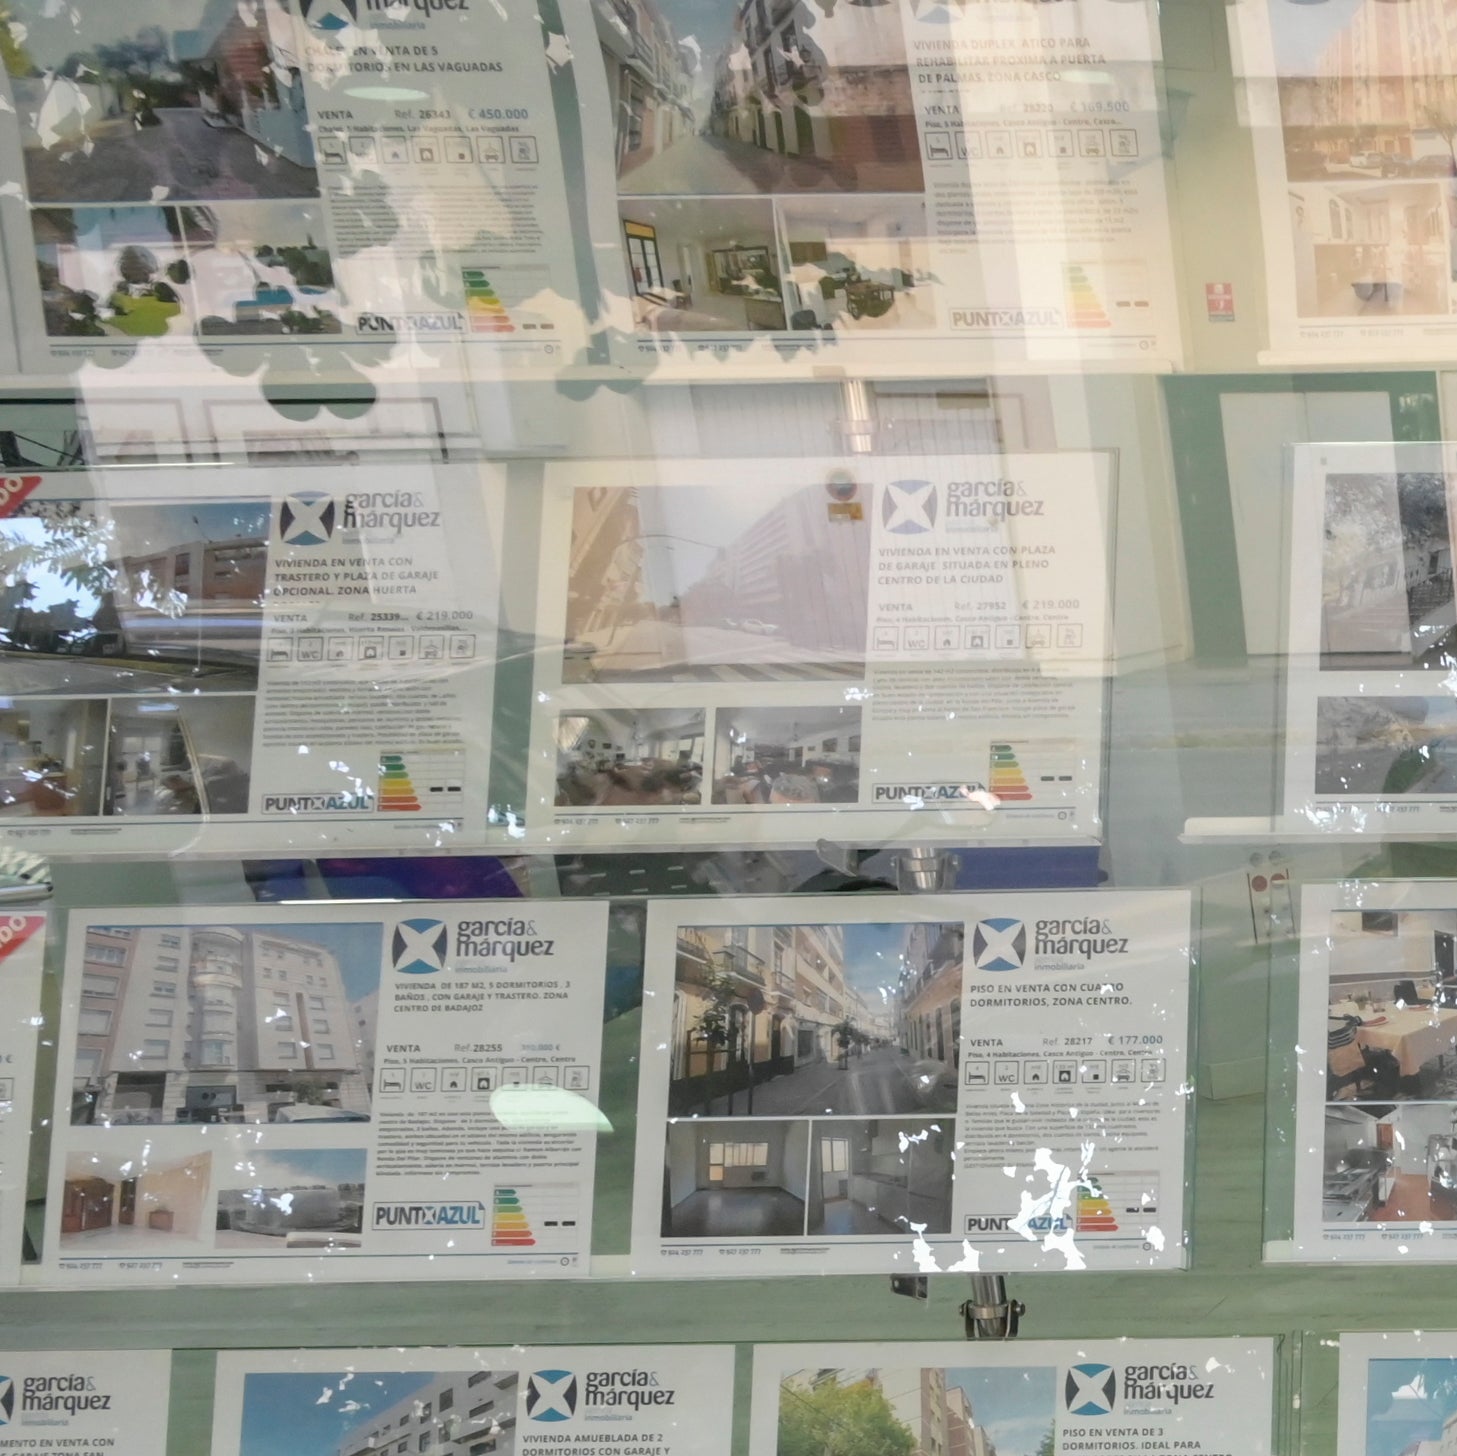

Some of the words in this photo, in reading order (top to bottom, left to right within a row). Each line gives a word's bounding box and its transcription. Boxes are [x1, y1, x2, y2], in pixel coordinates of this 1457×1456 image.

[414, 62, 435, 72] LAS
[438, 62, 503, 72] VAGUADAS
[924, 105, 959, 115] VENTA
[877, 575, 923, 585] CENTRO
[926, 575, 939, 585] DE
[944, 575, 957, 584] LA
[960, 574, 1004, 584] CIUDAD
[1035, 936, 1129, 960] márquez
[970, 984, 995, 994] PISO
[998, 984, 1012, 994] EN
[1015, 983, 1051, 993] VENTA
[1052, 983, 1077, 993] CON
[970, 997, 1050, 1008] DORMITORIOS,
[1052, 996, 1084, 1006] ZONA
[1086, 996, 1133, 1006] CENTRO.
[394, 1004, 429, 1012] CENTRO
[431, 1004, 442, 1012] DE
[444, 1004, 483, 1012] BADAJOZ
[1124, 1381, 1214, 1405] márquez
[585, 1388, 675, 1412] márquez
[522, 1434, 572, 1444] VIVIENDA
[574, 1433, 639, 1443] AMUEBLADA
[641, 1433, 654, 1442] DE
[657, 1433, 663, 1442] 2
